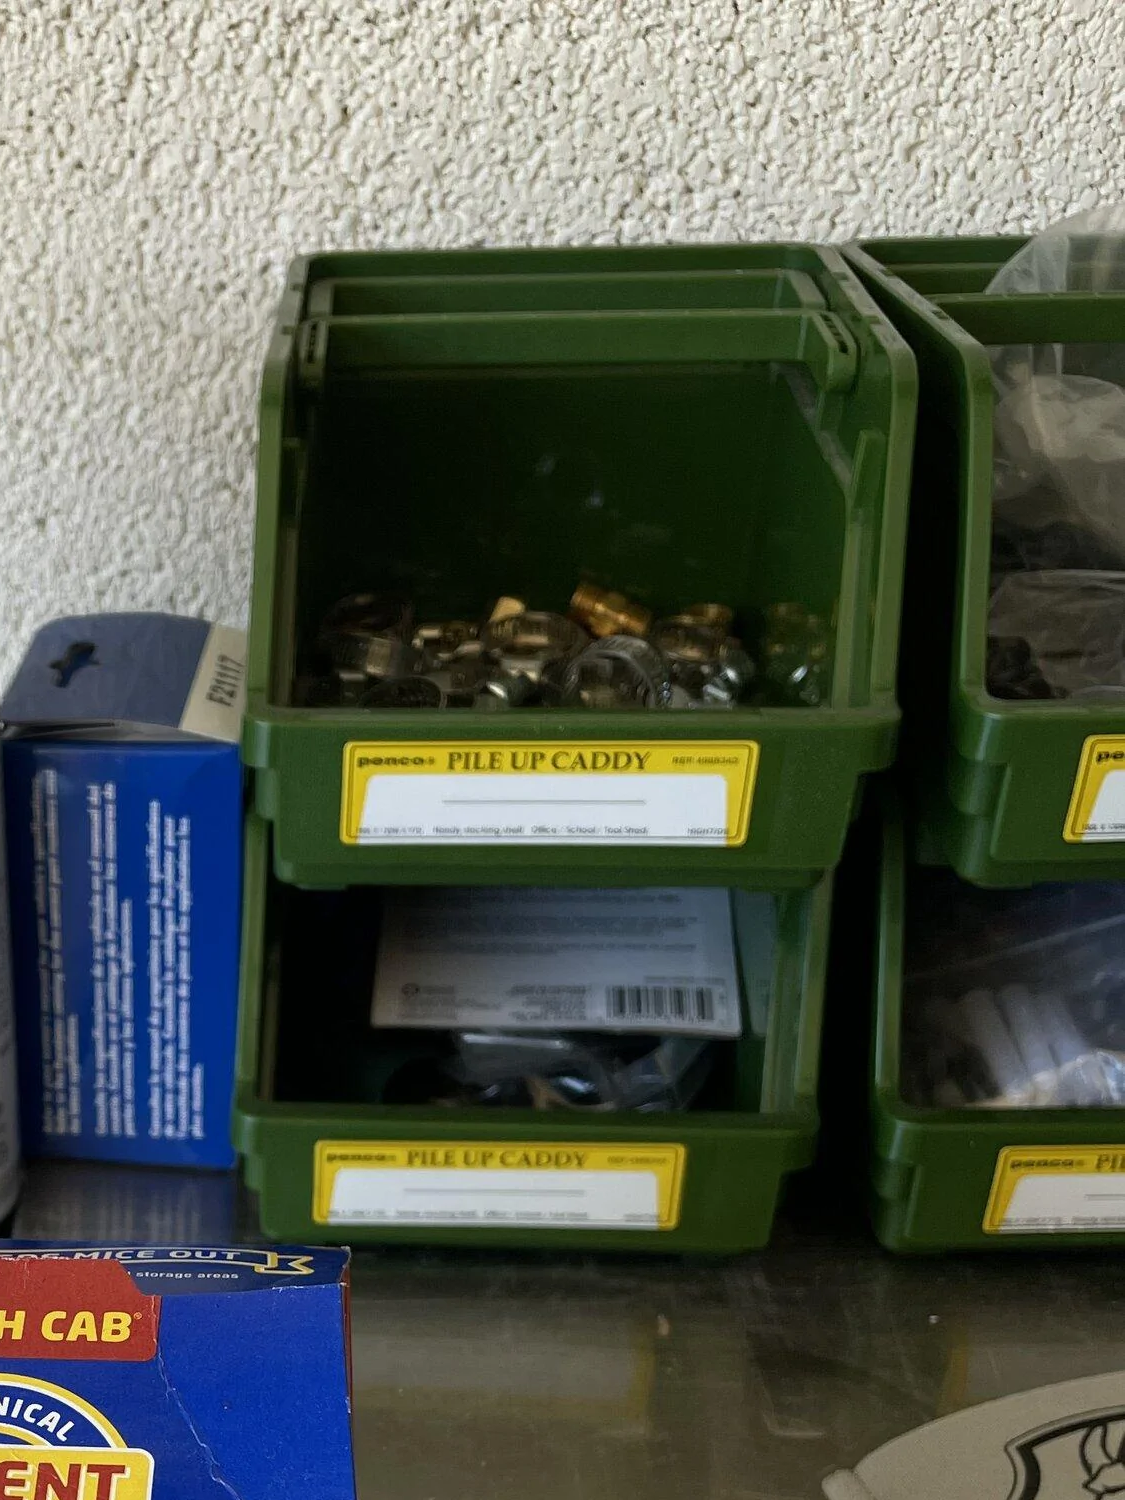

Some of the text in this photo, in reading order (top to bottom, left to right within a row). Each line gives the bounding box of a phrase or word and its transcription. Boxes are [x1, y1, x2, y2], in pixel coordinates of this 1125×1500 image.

[447, 751, 650, 771] PILE UP CADDY
[407, 1150, 587, 1168] PILE UP CADDY
[74, 1249, 155, 1260] MICE
[169, 1249, 242, 1260] OUT
[136, 1270, 240, 1280] storage areas
[40, 1310, 133, 1343] CAB
